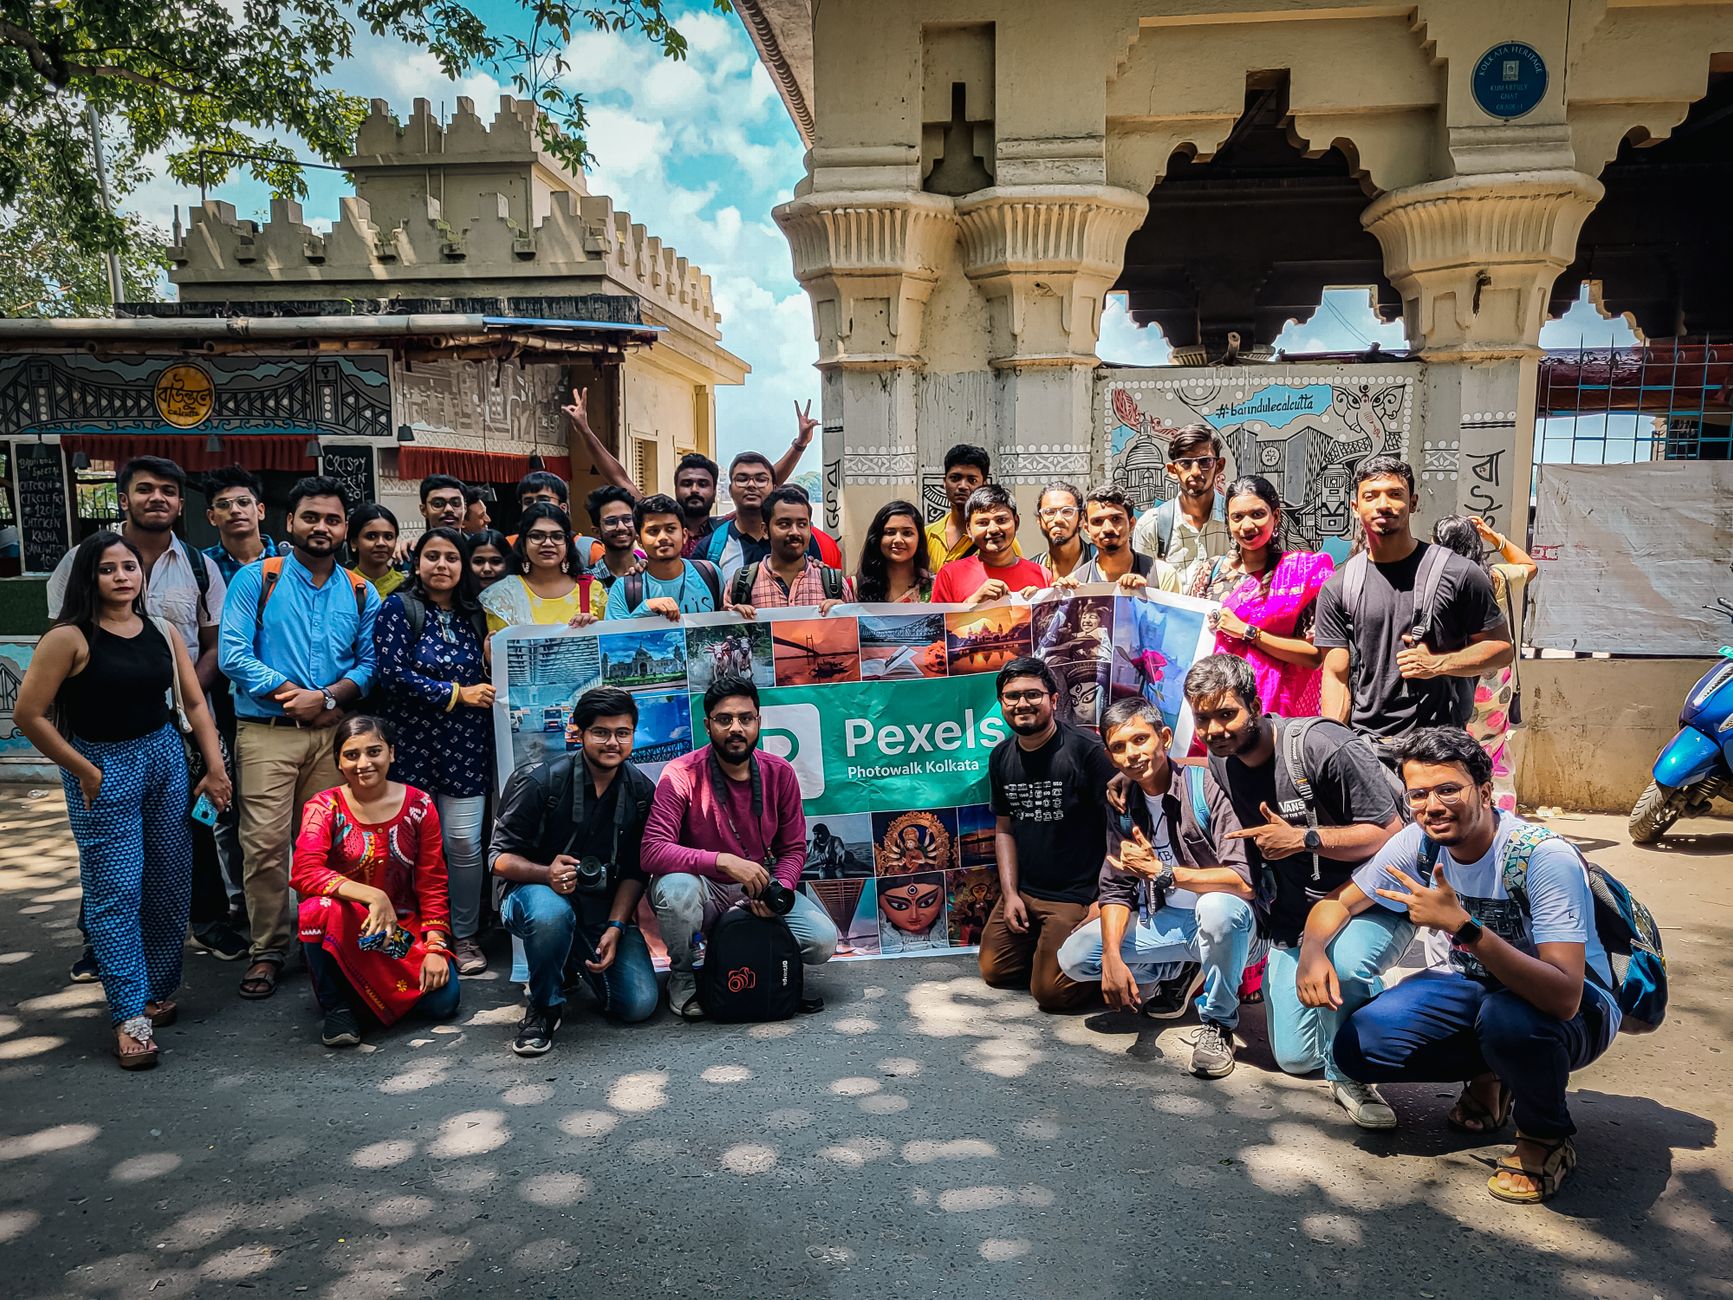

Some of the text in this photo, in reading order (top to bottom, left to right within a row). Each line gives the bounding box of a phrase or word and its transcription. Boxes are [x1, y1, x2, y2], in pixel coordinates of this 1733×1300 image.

[1478, 45, 1543, 77] KOLKATA HERITAGE
[325, 454, 367, 477] CRISPY
[22, 516, 61, 528] CHICKEN
[845, 708, 1005, 757] Pexels
[847, 758, 979, 779] Photowalk Kolkata
[1278, 798, 1306, 813] VANS
